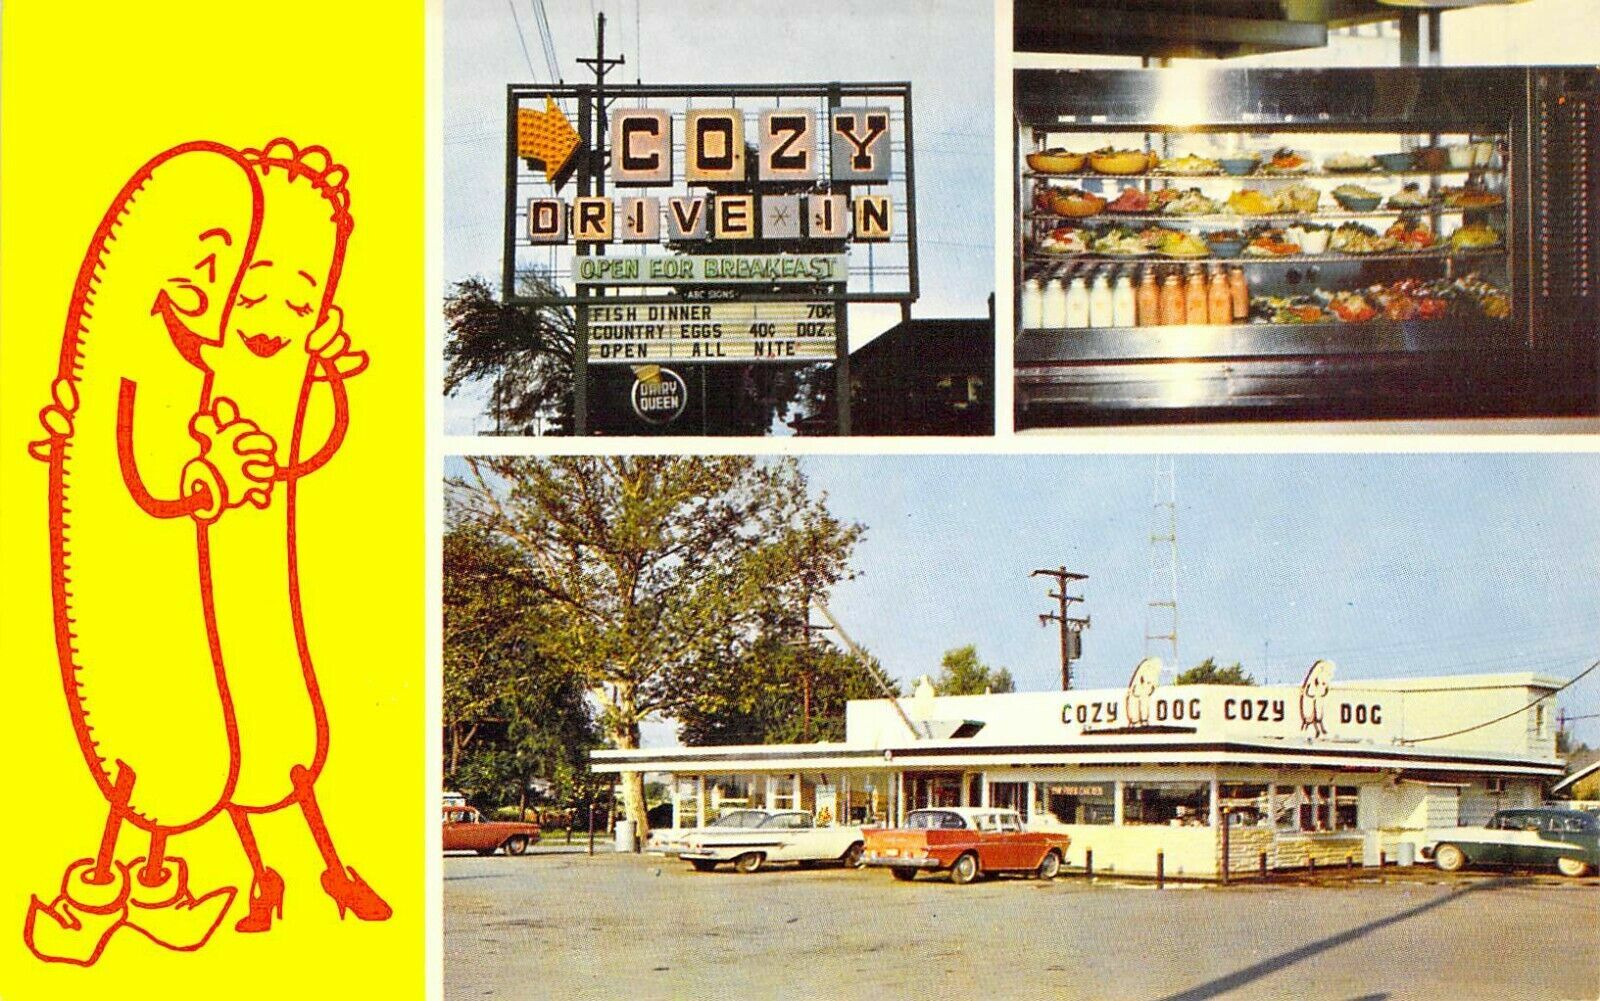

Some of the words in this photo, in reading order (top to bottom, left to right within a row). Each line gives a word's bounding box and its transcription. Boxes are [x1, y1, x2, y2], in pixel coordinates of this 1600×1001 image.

[622, 116, 886, 169] COZY
[532, 200, 747, 235] DRIVE
[823, 199, 887, 233] IN
[580, 259, 640, 279] OPEN
[650, 259, 694, 279] FOR
[704, 257, 837, 280] BREAKFAST
[594, 307, 637, 321] FISH
[649, 306, 711, 320] DINNER
[806, 305, 833, 319] 70¢
[593, 325, 664, 340] COUNTRY
[681, 324, 722, 338] EGGS
[749, 323, 776, 338] 40¢
[601, 344, 648, 358] OPEN
[692, 342, 726, 357] ALL
[754, 341, 795, 356] NITE
[640, 381, 677, 396] DAIRY
[640, 395, 679, 411] QUEEN
[1062, 702, 1118, 724] COZY
[1157, 699, 1201, 721] DOG
[1224, 698, 1285, 722] COZY
[1341, 703, 1382, 725] DOG
